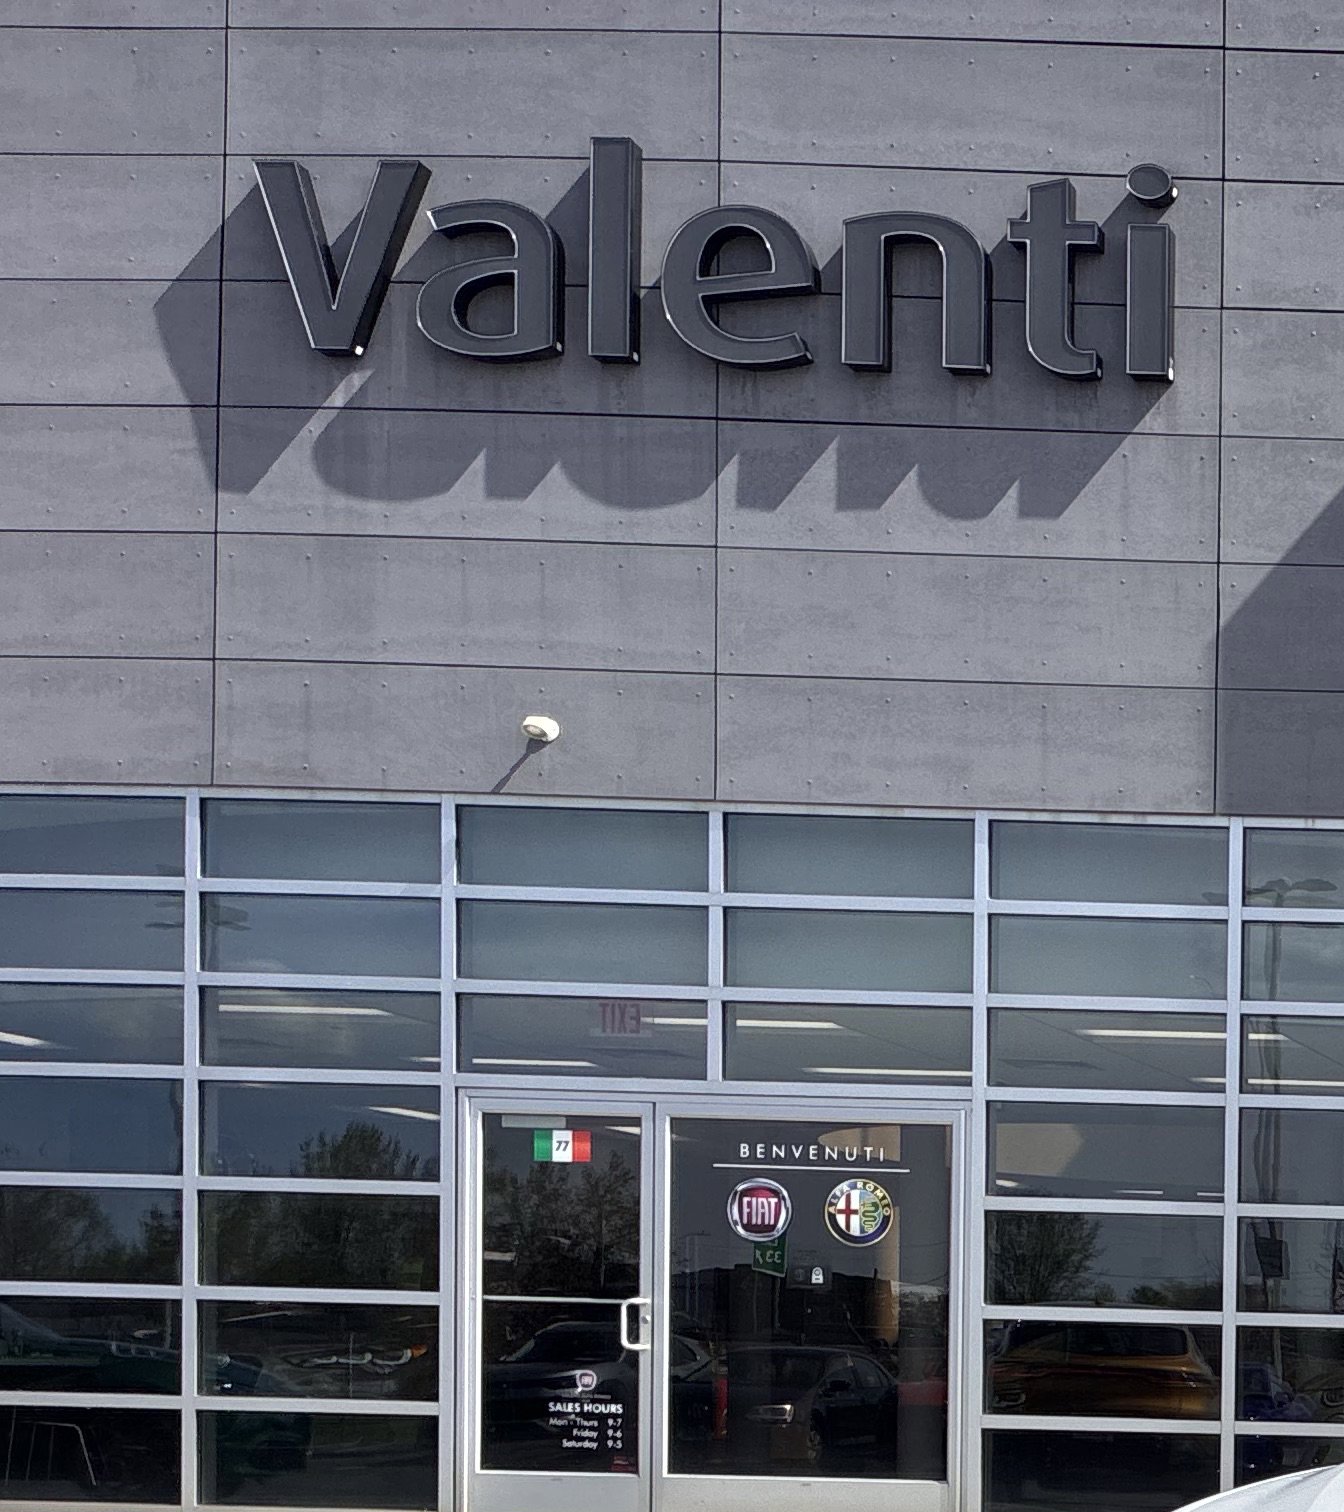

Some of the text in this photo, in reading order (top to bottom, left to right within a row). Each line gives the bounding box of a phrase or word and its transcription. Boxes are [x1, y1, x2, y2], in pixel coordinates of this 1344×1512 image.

[252, 136, 1178, 381] Valenti
[555, 1141, 570, 1152] 77
[740, 1143, 885, 1162] BENVENUTI
[828, 1181, 891, 1216] ALFA ROMEO
[742, 1196, 779, 1225] FIAT
[548, 1402, 623, 1414] SALES HOURS
[549, 1417, 568, 1426] Mon
[576, 1418, 598, 1427] Thurs
[572, 1428, 598, 1439] Friday
[562, 1439, 598, 1450] Saturday
